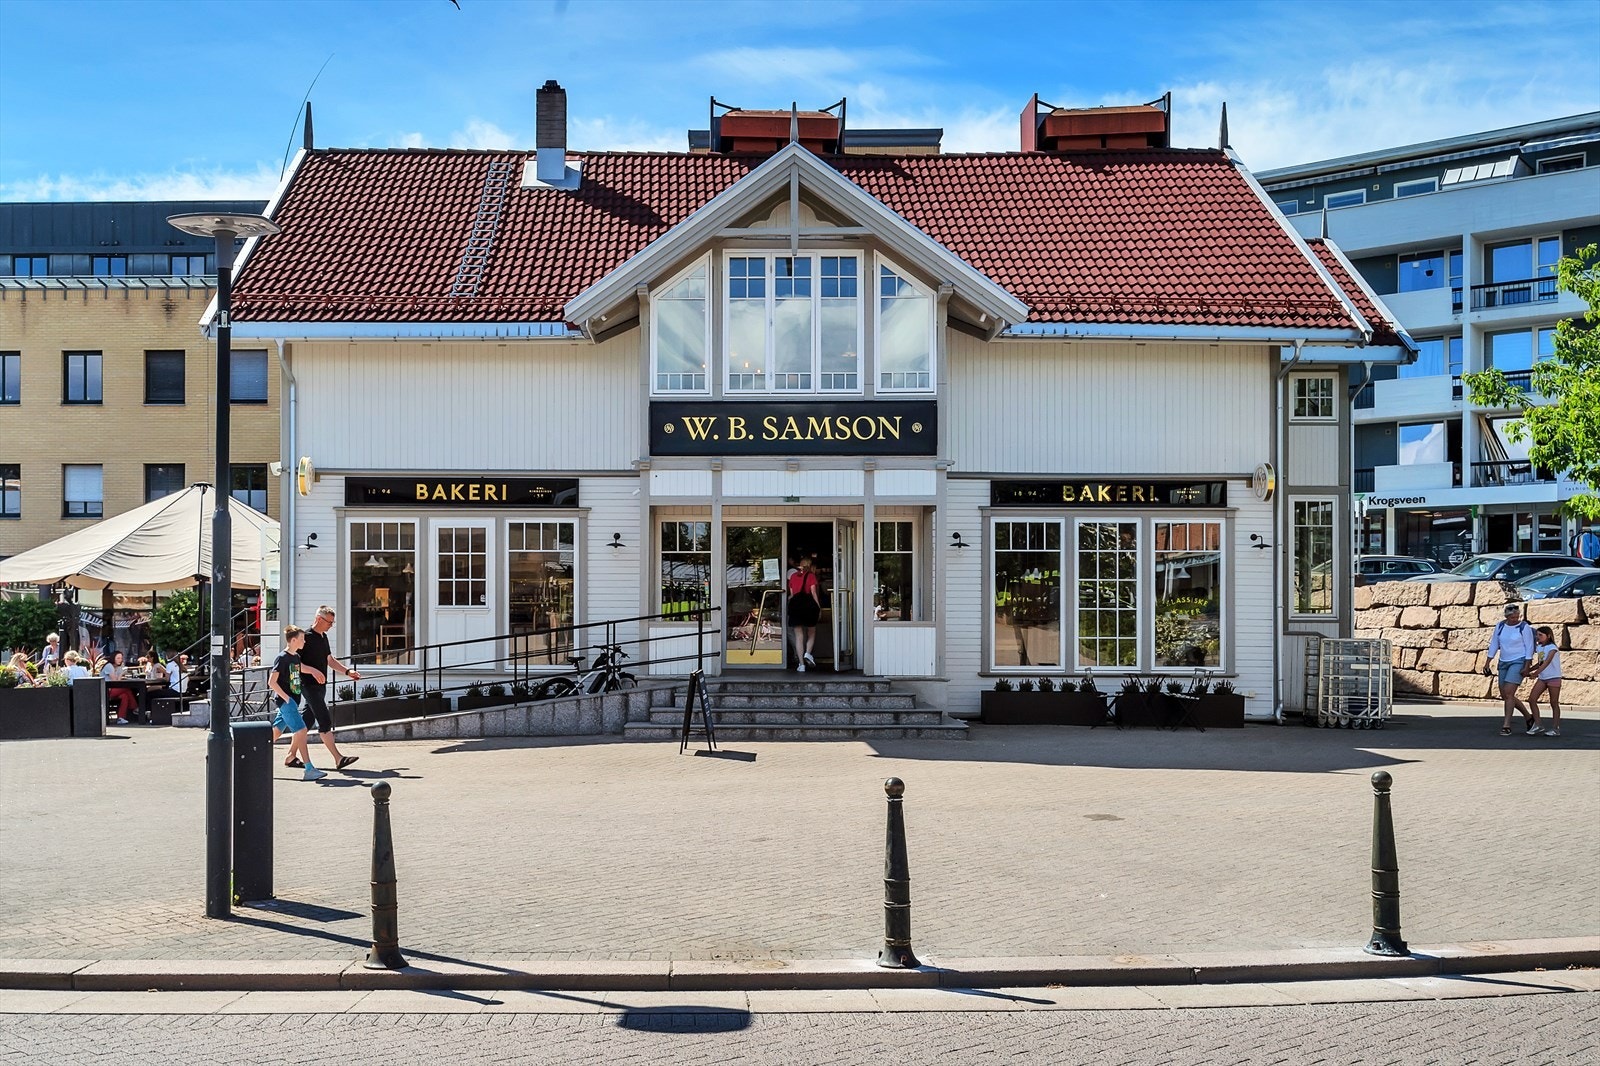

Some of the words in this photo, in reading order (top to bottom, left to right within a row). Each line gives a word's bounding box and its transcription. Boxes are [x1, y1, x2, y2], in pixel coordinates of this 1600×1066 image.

[681, 416, 719, 441] W.
[727, 416, 754, 441] B.
[762, 416, 902, 441] SAMSON
[415, 483, 507, 501] BAKERI
[1062, 484, 1155, 502] BAKERI
[1368, 495, 1426, 508] Krogsveen
